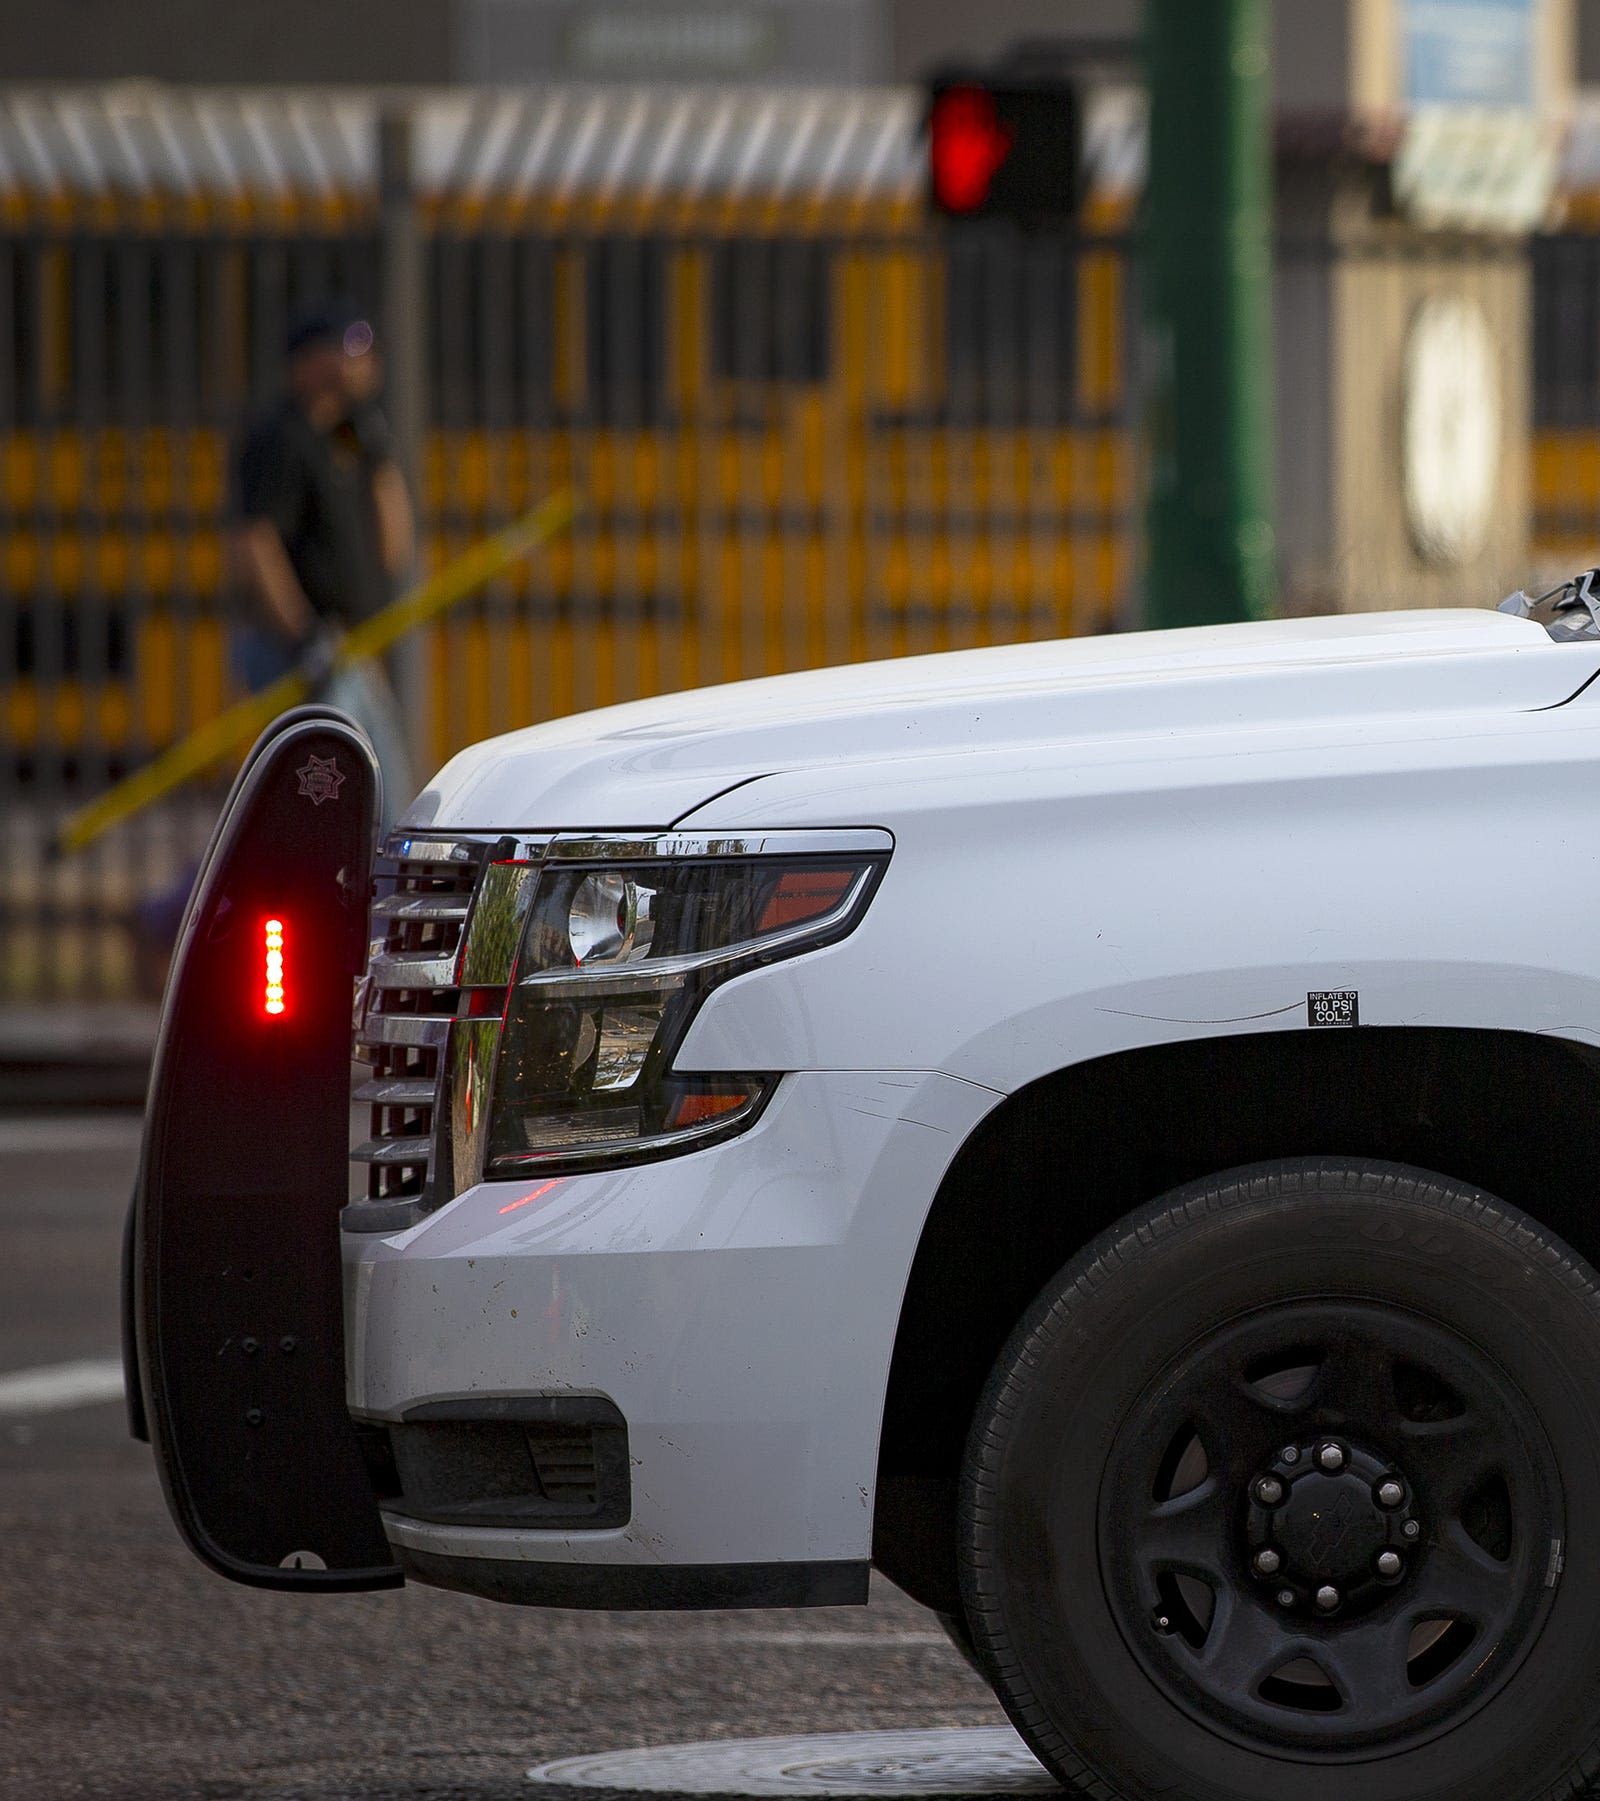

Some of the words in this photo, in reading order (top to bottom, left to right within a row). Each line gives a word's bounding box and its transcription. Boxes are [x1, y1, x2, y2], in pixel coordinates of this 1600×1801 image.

[1344, 992, 1356, 1000] TO
[1313, 1001, 1329, 1011] 40
[1332, 1000, 1353, 1011] PSI
[1316, 1011, 1351, 1022] COLD
